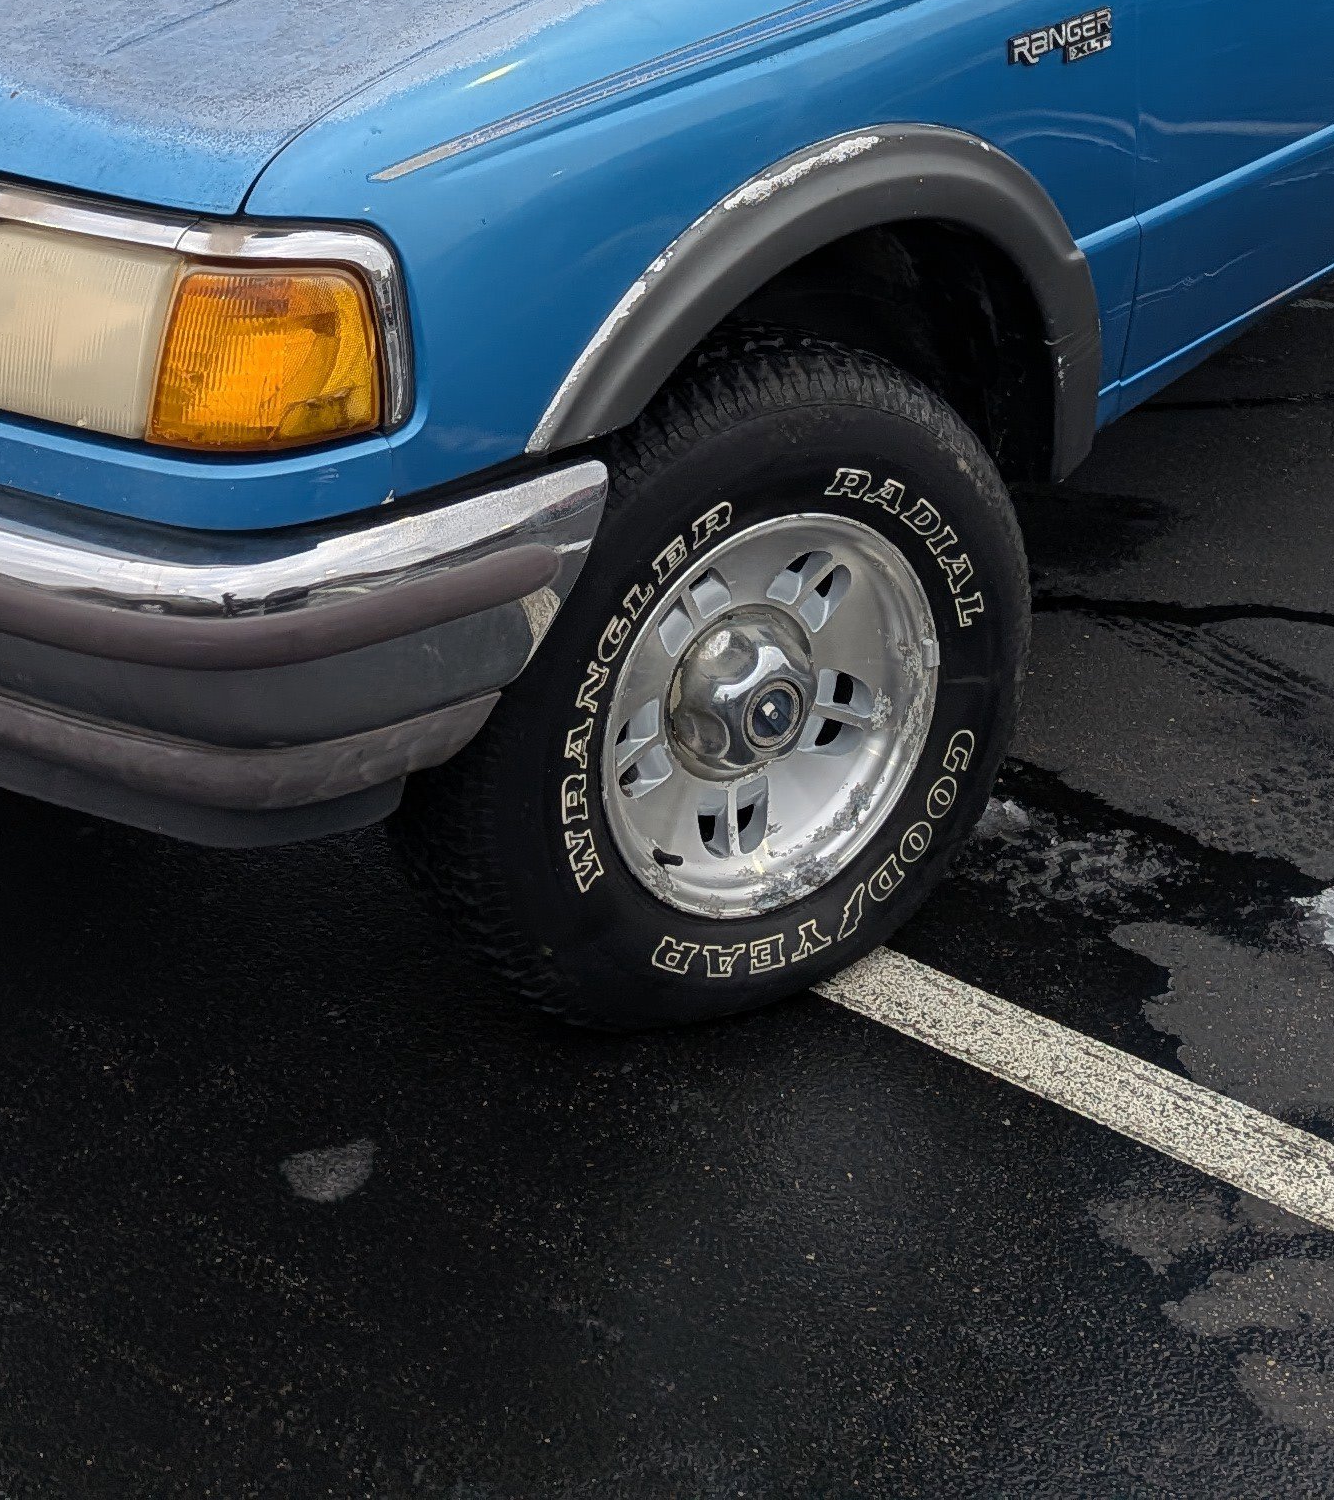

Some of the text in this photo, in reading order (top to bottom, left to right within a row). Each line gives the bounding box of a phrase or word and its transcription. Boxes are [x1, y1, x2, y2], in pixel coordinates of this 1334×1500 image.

[1013, 7, 1112, 63] RANGER
[1074, 34, 1110, 58] XLT
[824, 467, 984, 627] RADIAL
[562, 501, 732, 892] WRANGLER
